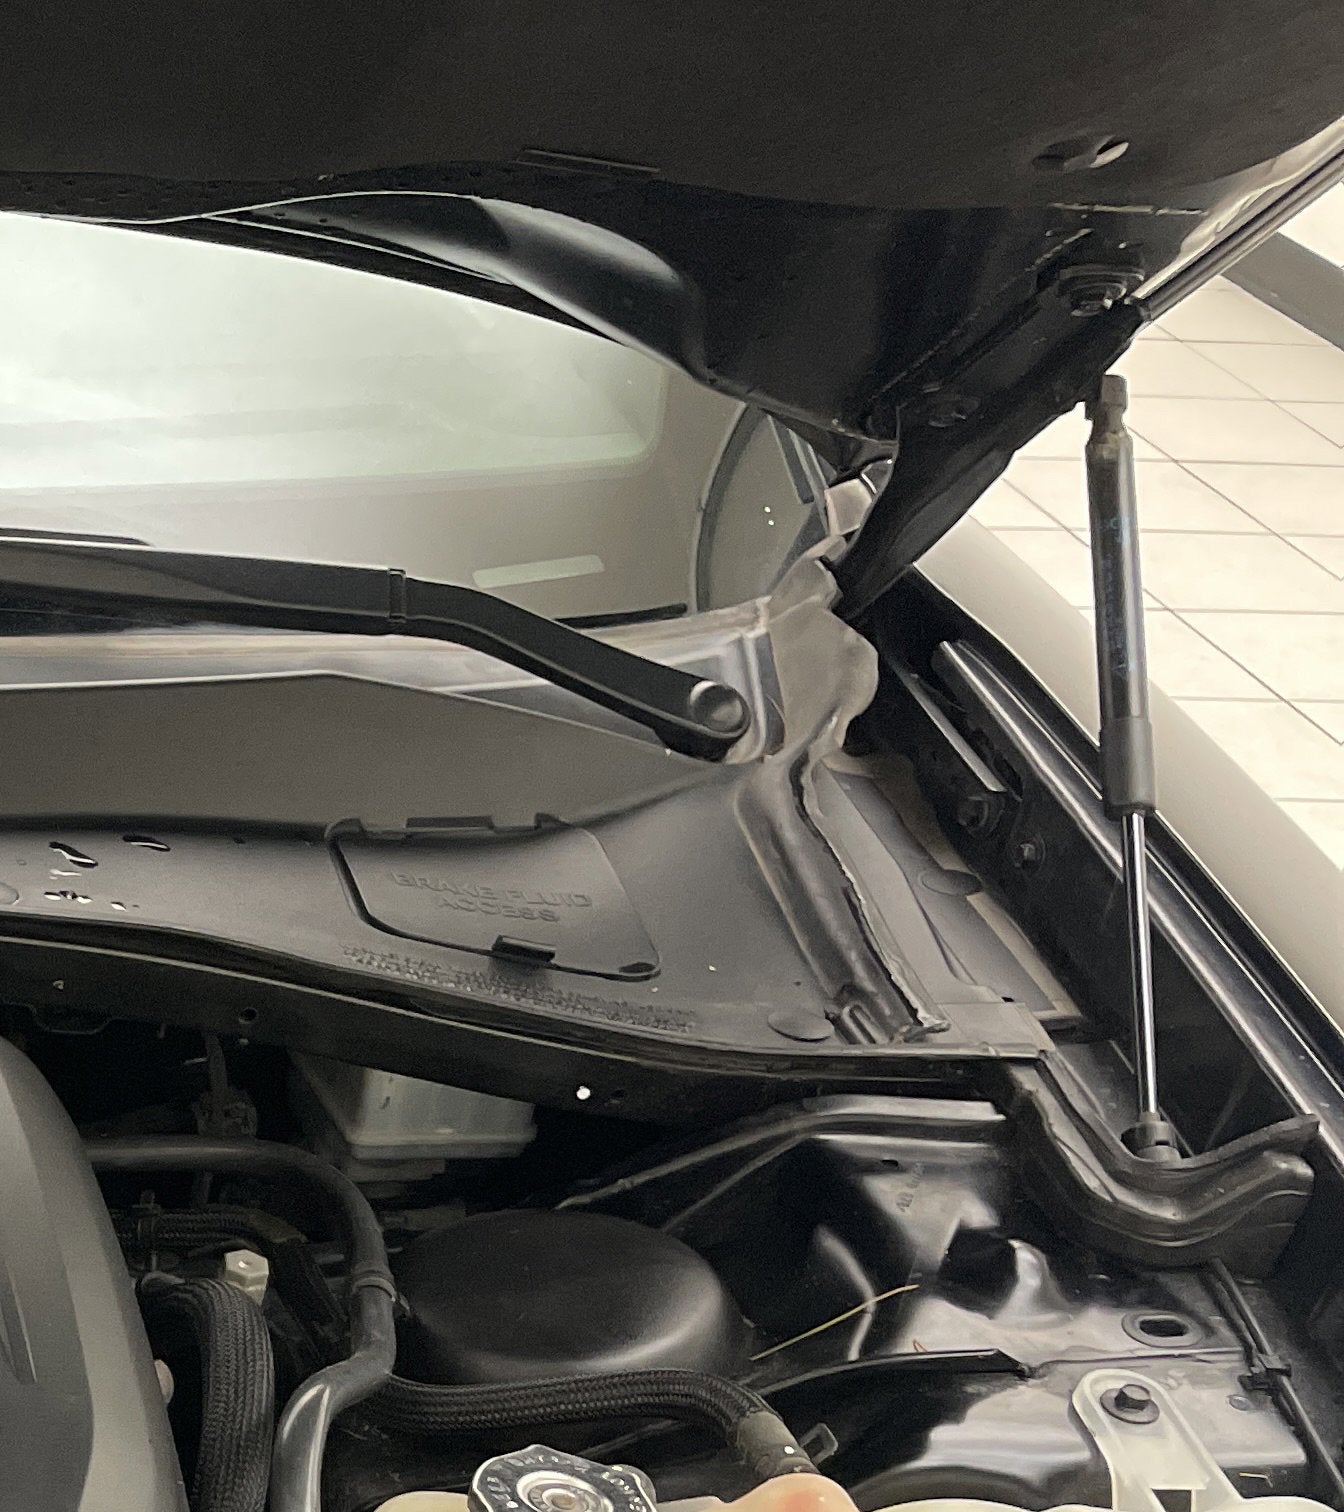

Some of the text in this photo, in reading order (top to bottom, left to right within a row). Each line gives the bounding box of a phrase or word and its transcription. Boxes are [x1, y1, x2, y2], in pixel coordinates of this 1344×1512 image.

[392, 872, 592, 907] BRAKE FLUID
[438, 896, 560, 922] ACCESS
